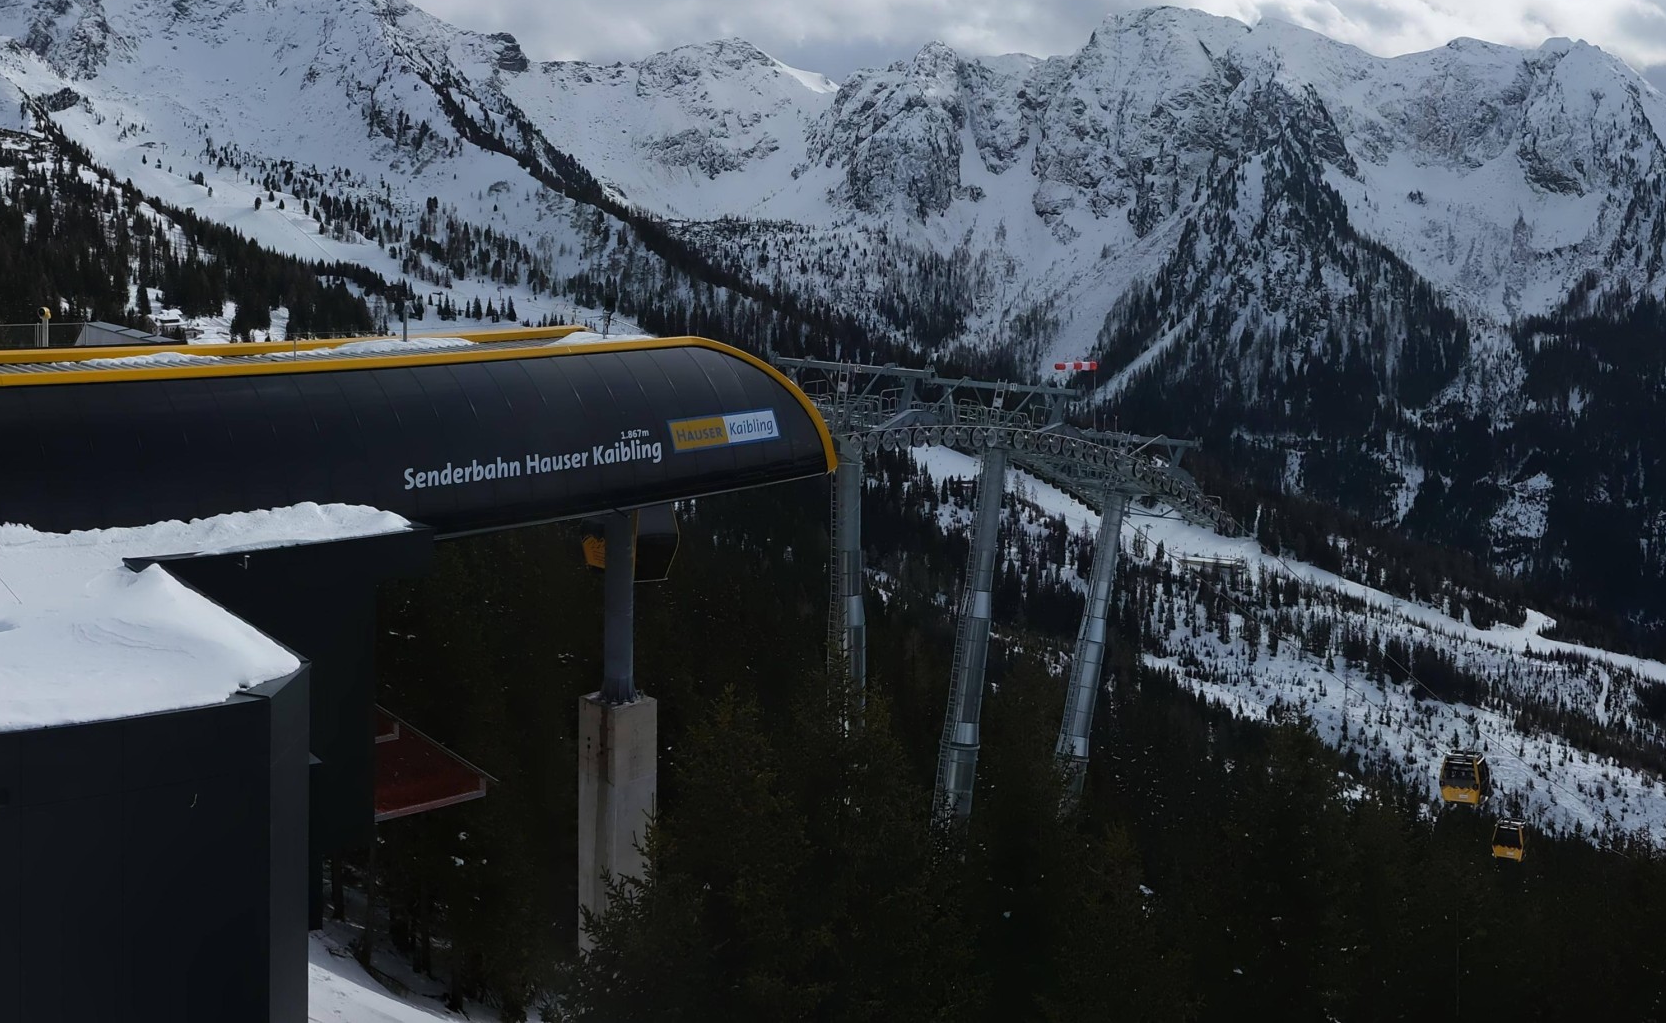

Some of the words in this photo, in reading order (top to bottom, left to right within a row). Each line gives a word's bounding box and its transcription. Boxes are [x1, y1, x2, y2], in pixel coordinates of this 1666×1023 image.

[620, 429, 650, 440] 1.867m
[675, 426, 723, 443] HAUSER
[729, 417, 774, 436] Kaibling
[404, 456, 521, 490] Senderbahn
[526, 450, 588, 474] Hauser
[592, 439, 662, 465] Kaibling
